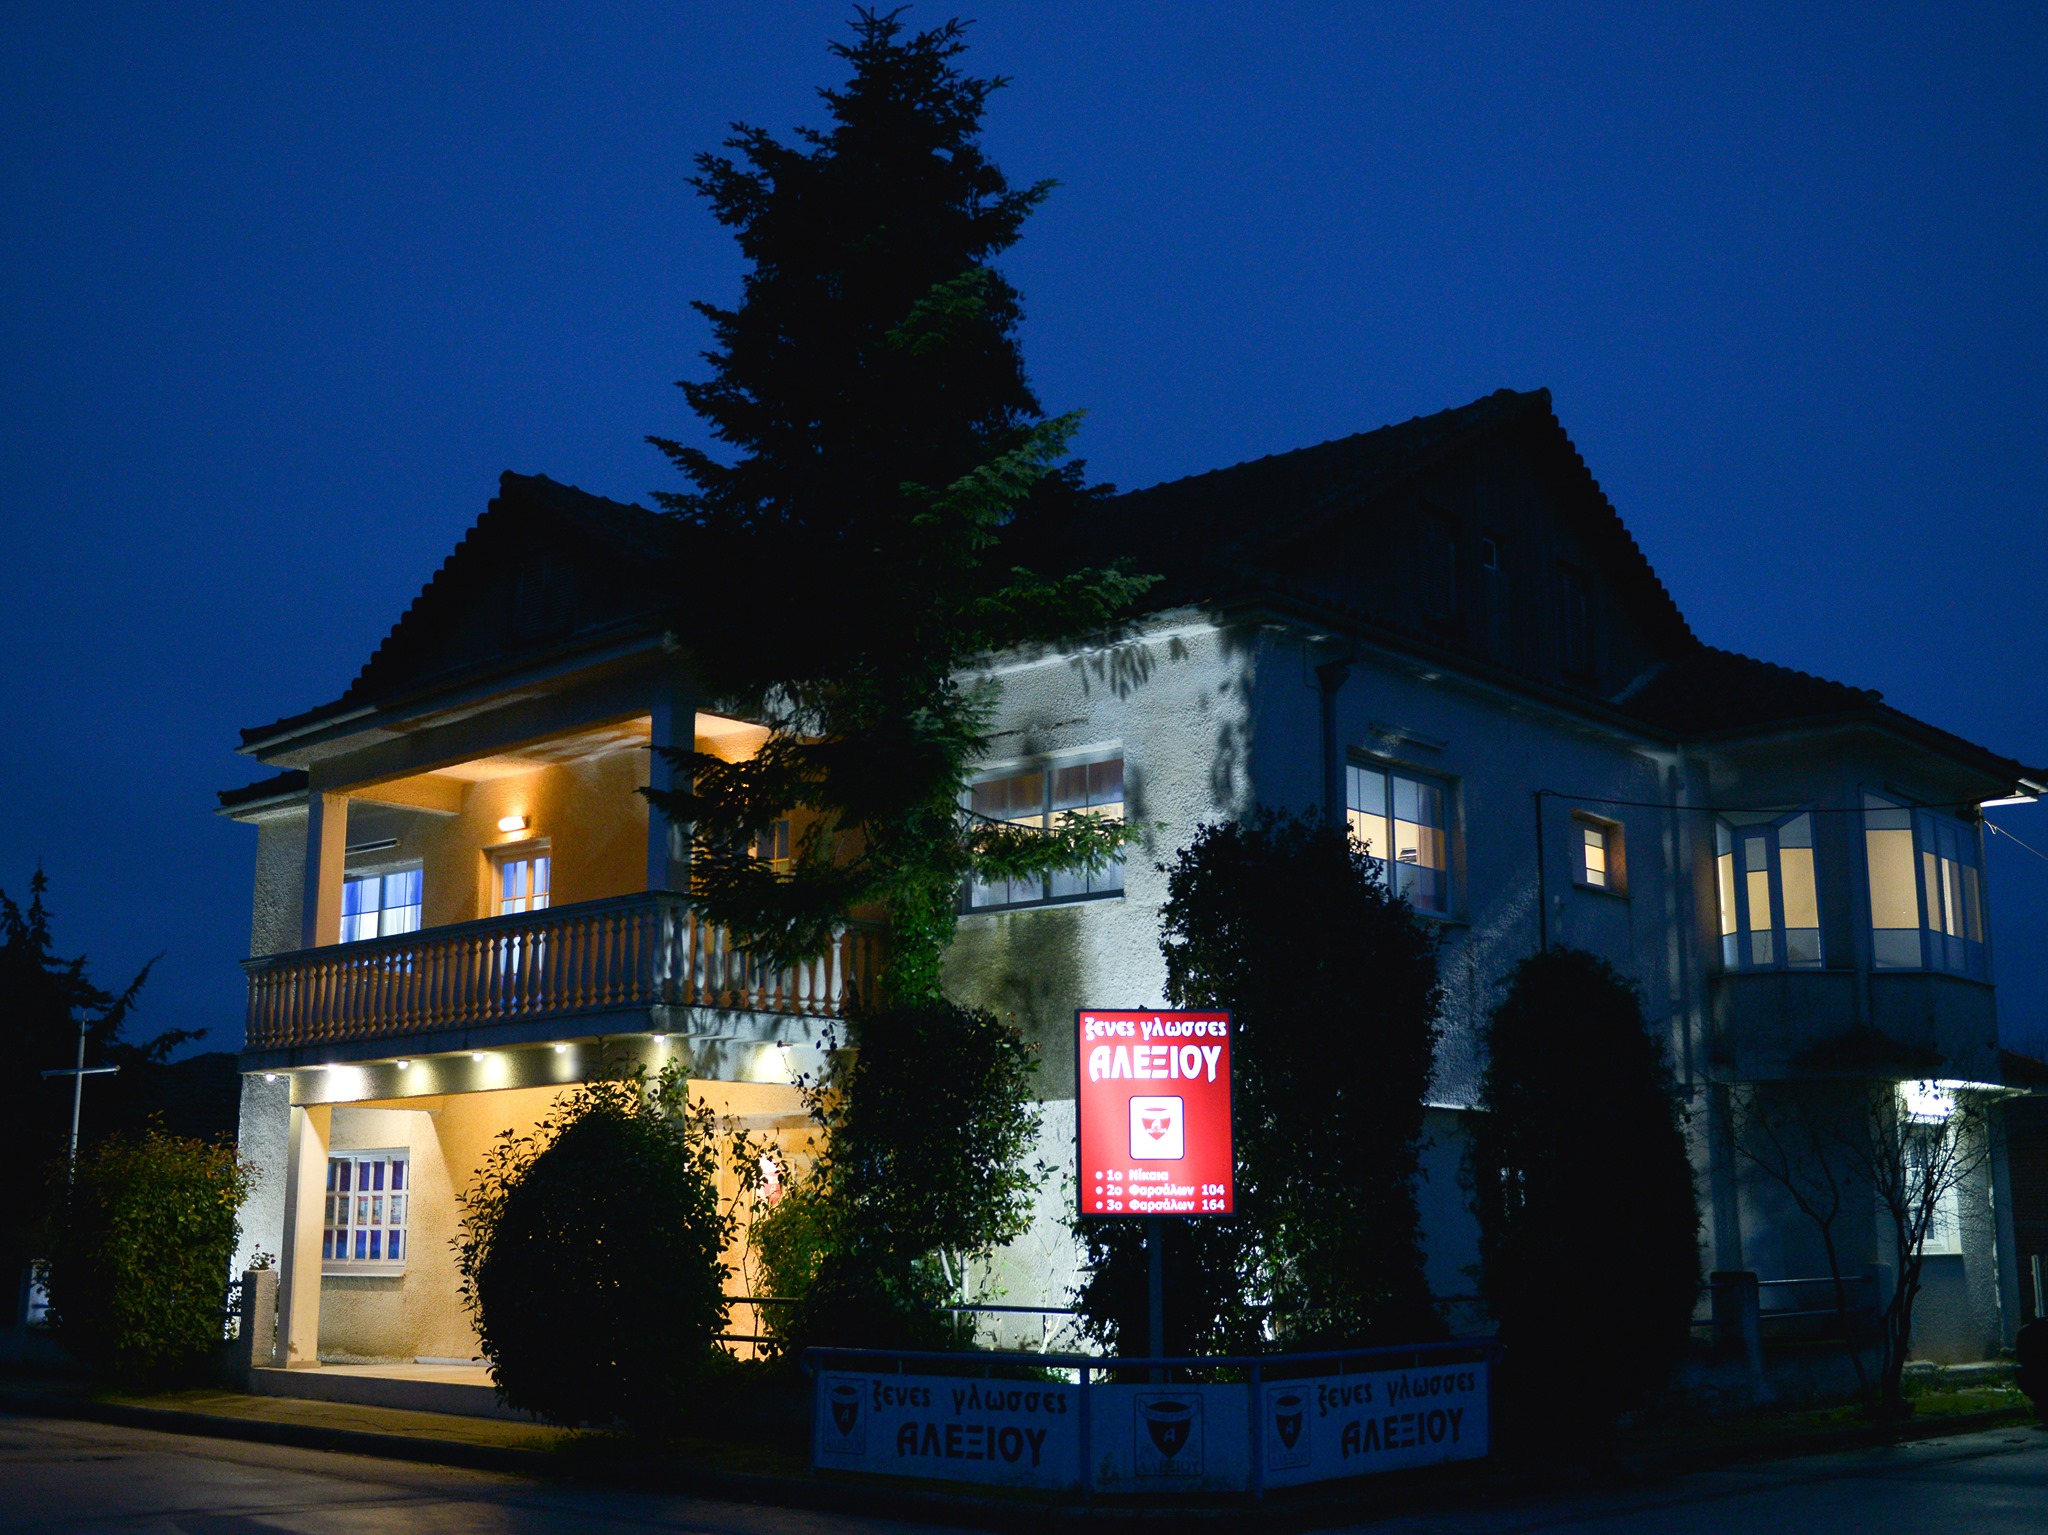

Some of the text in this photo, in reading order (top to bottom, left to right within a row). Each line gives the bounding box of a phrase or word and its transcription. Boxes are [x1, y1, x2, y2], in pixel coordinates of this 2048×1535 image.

[1085, 1016, 1227, 1040] ξενες γλωσσες
[1088, 1045, 1222, 1083] ΑΛΕΞΙΟΥ
[1128, 1183, 1195, 1198] Φαρσάλων
[1201, 1184, 1225, 1196] 104
[1128, 1198, 1195, 1213] Φαρσάλων
[1201, 1199, 1225, 1211] 164
[872, 1379, 1067, 1415] ξενες γλωσσες
[1317, 1372, 1475, 1417] ξενες γλωσσες
[897, 1421, 1048, 1468] ΑΛΕΞΙΟΥ
[1341, 1407, 1464, 1460] ΑΛΕΞΙΟΥ
